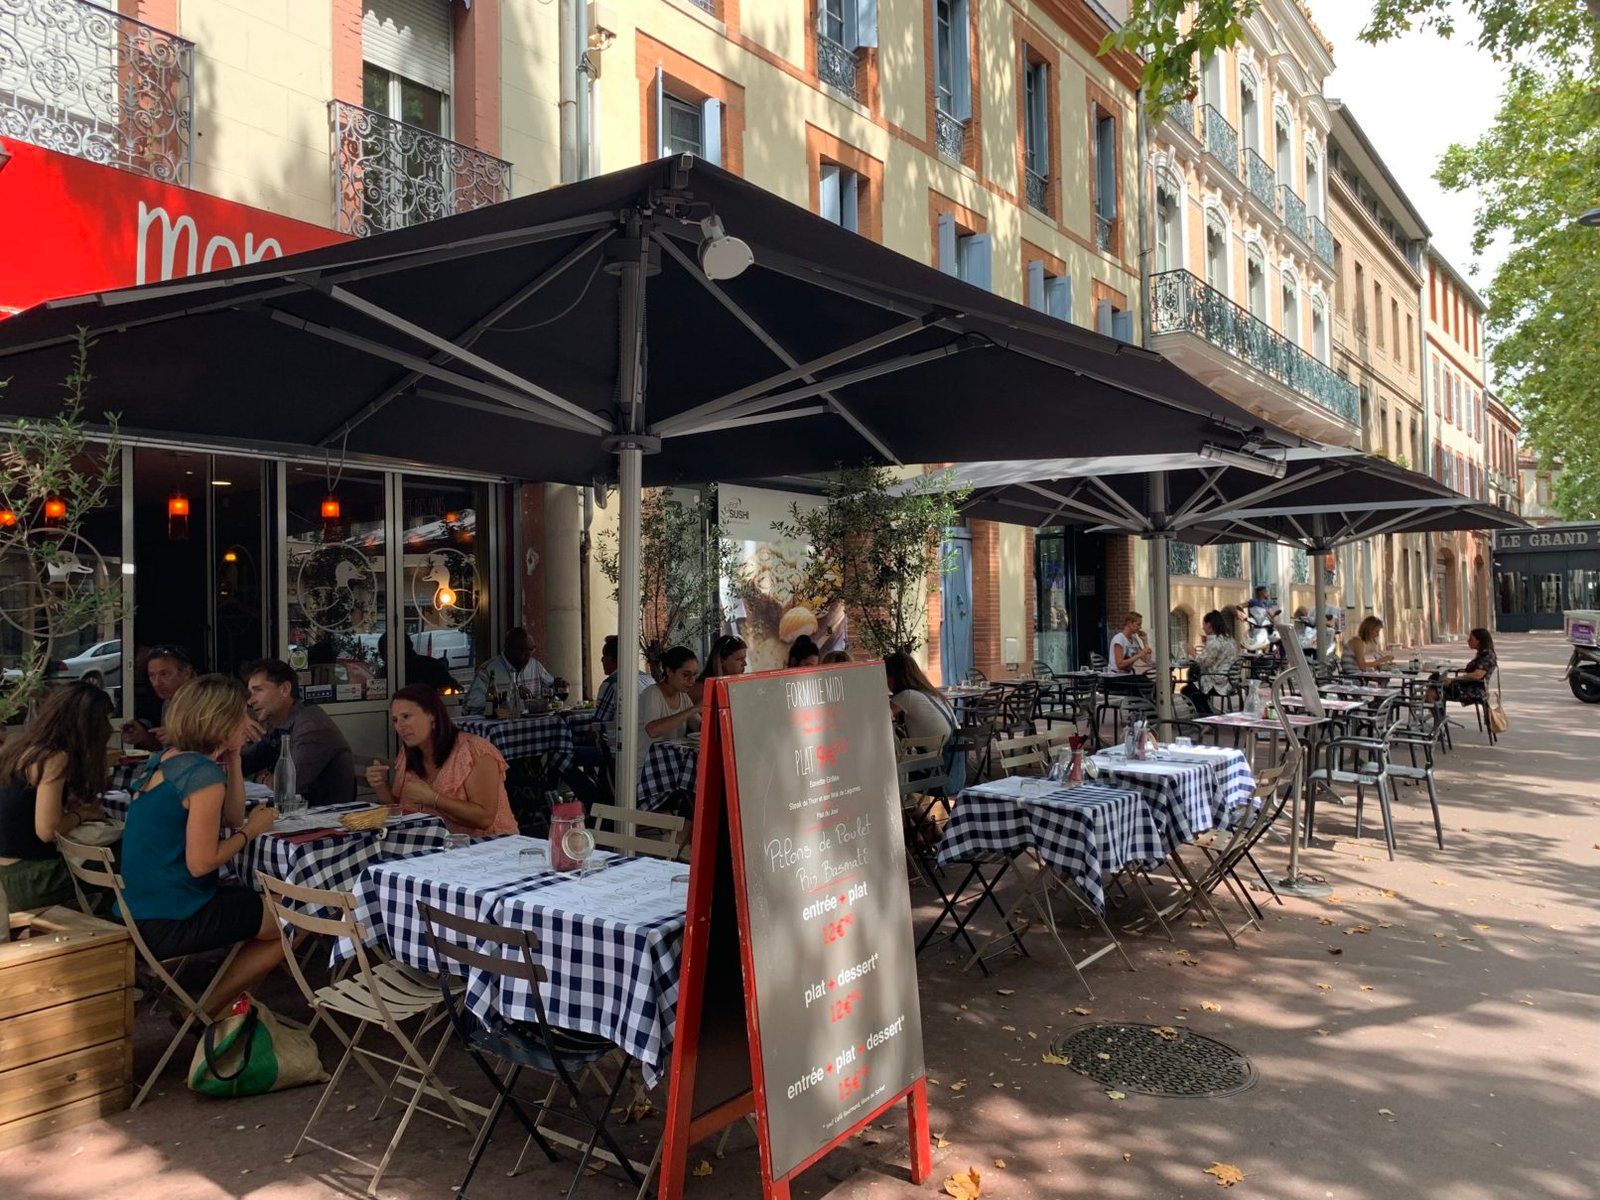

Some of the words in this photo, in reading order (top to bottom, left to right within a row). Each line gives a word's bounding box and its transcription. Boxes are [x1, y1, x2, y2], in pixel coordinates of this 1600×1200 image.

[1501, 535, 1520, 548] LE
[1529, 532, 1589, 547] GRAND
[785, 679, 825, 709] FORMULE
[825, 676, 845, 702] MIDI
[795, 746, 814, 776] PLAT
[819, 832, 832, 852] de
[835, 813, 872, 844] Poulet
[802, 894, 837, 920] entrée
[848, 881, 868, 906] plat
[804, 980, 826, 1008] plat
[787, 1067, 824, 1099] entrée
[835, 1045, 856, 1074] plat
